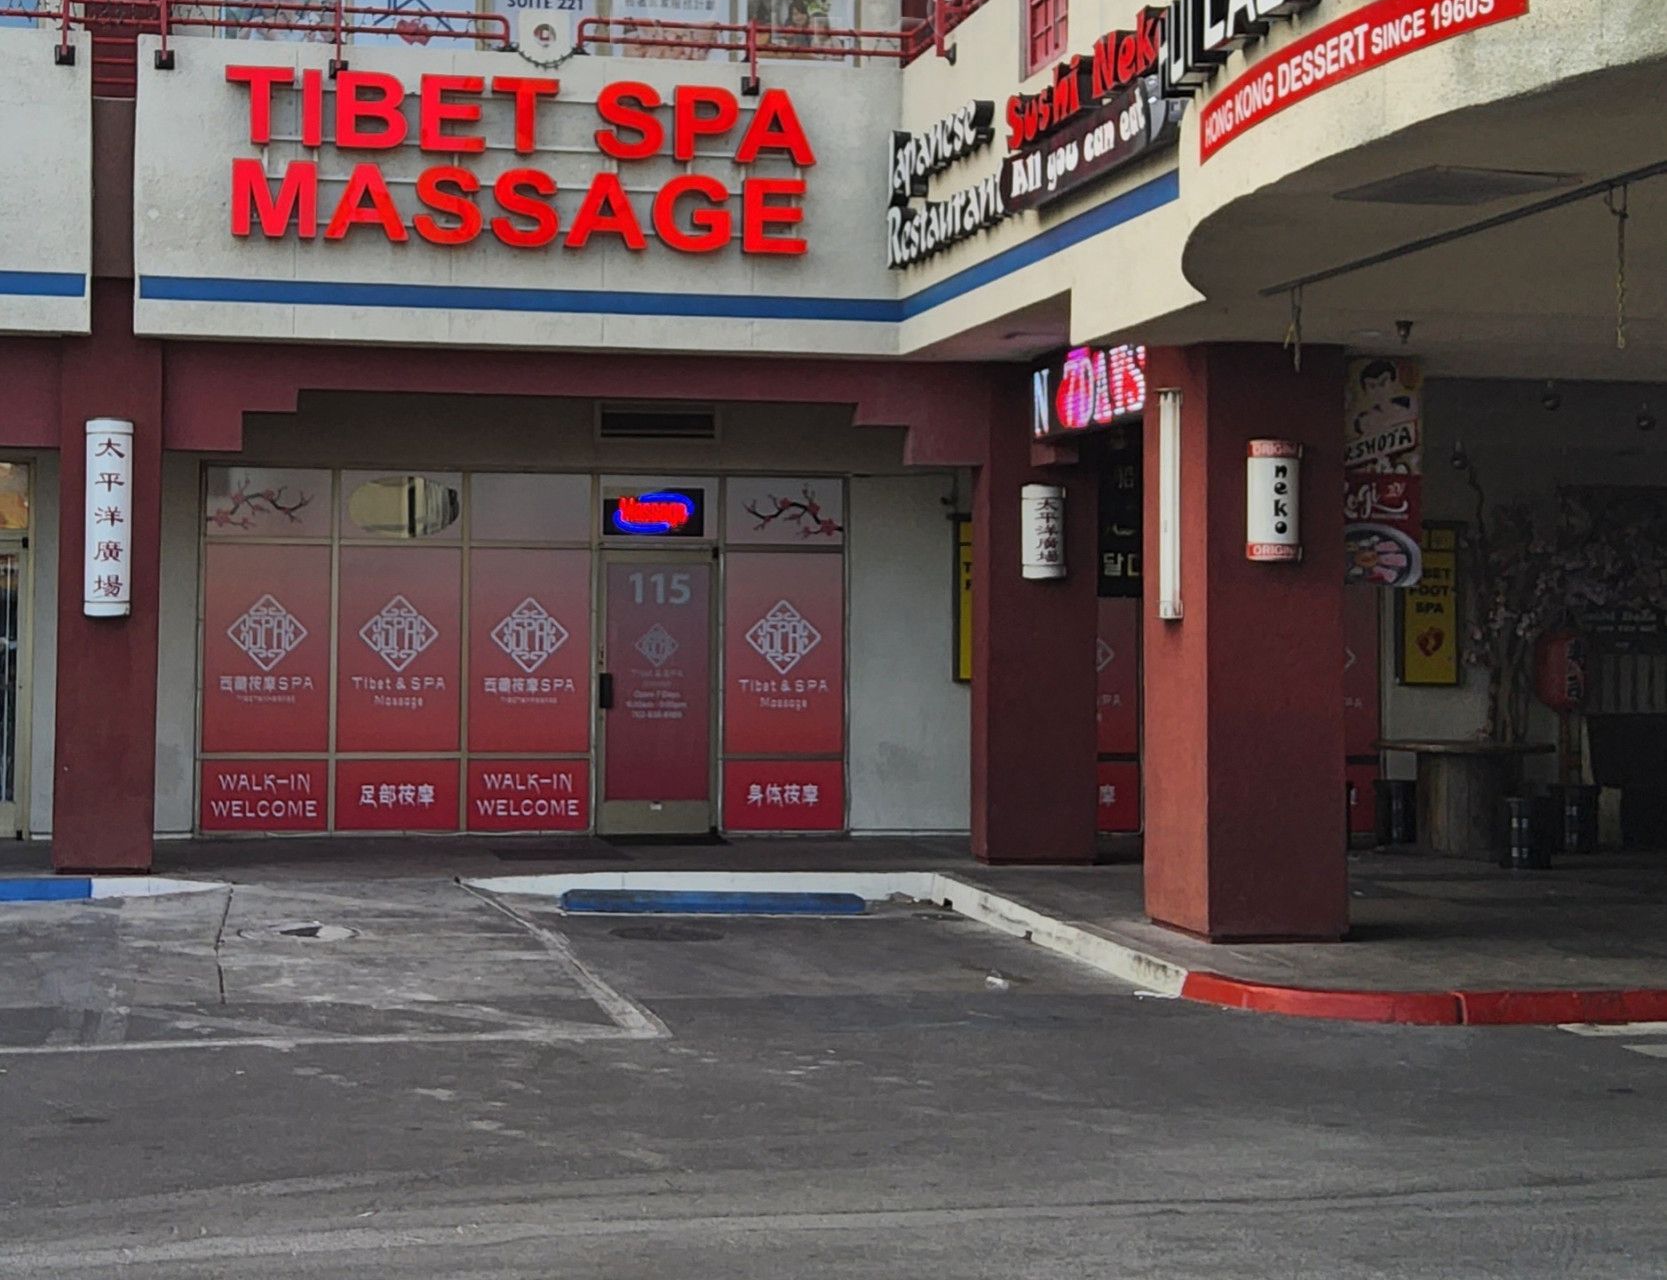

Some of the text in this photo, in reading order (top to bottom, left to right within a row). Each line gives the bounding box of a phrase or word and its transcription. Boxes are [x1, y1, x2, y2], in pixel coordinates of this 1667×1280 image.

[1205, 99, 1233, 147] HONG
[1235, 72, 1274, 129] KONG
[1277, 23, 1369, 98] DESSERT
[1371, 8, 1426, 56] SINCE
[225, 65, 816, 166] TIBET SPA
[1006, 54, 1080, 150] Sushi
[888, 100, 977, 204] Japanese
[1010, 88, 1145, 198] All you can eat
[231, 157, 808, 254] MASSAGE
[888, 173, 1004, 265] Restaurant
[1274, 465, 1288, 534] neko
[93, 437, 125, 597] 太平洋廣場
[629, 572, 691, 604] 115
[1416, 602, 1444, 614] SPA
[352, 676, 446, 690] Tibet & SPA
[738, 679, 829, 693] Tibet & SPA
[374, 695, 424, 709] Massage
[760, 697, 808, 711] Massage
[218, 773, 311, 794] WALK-IN
[359, 783, 435, 808] 足部按摩
[483, 773, 573, 793] WALK-IN
[211, 800, 318, 818] WELCOME
[477, 799, 580, 817] WELCOME
